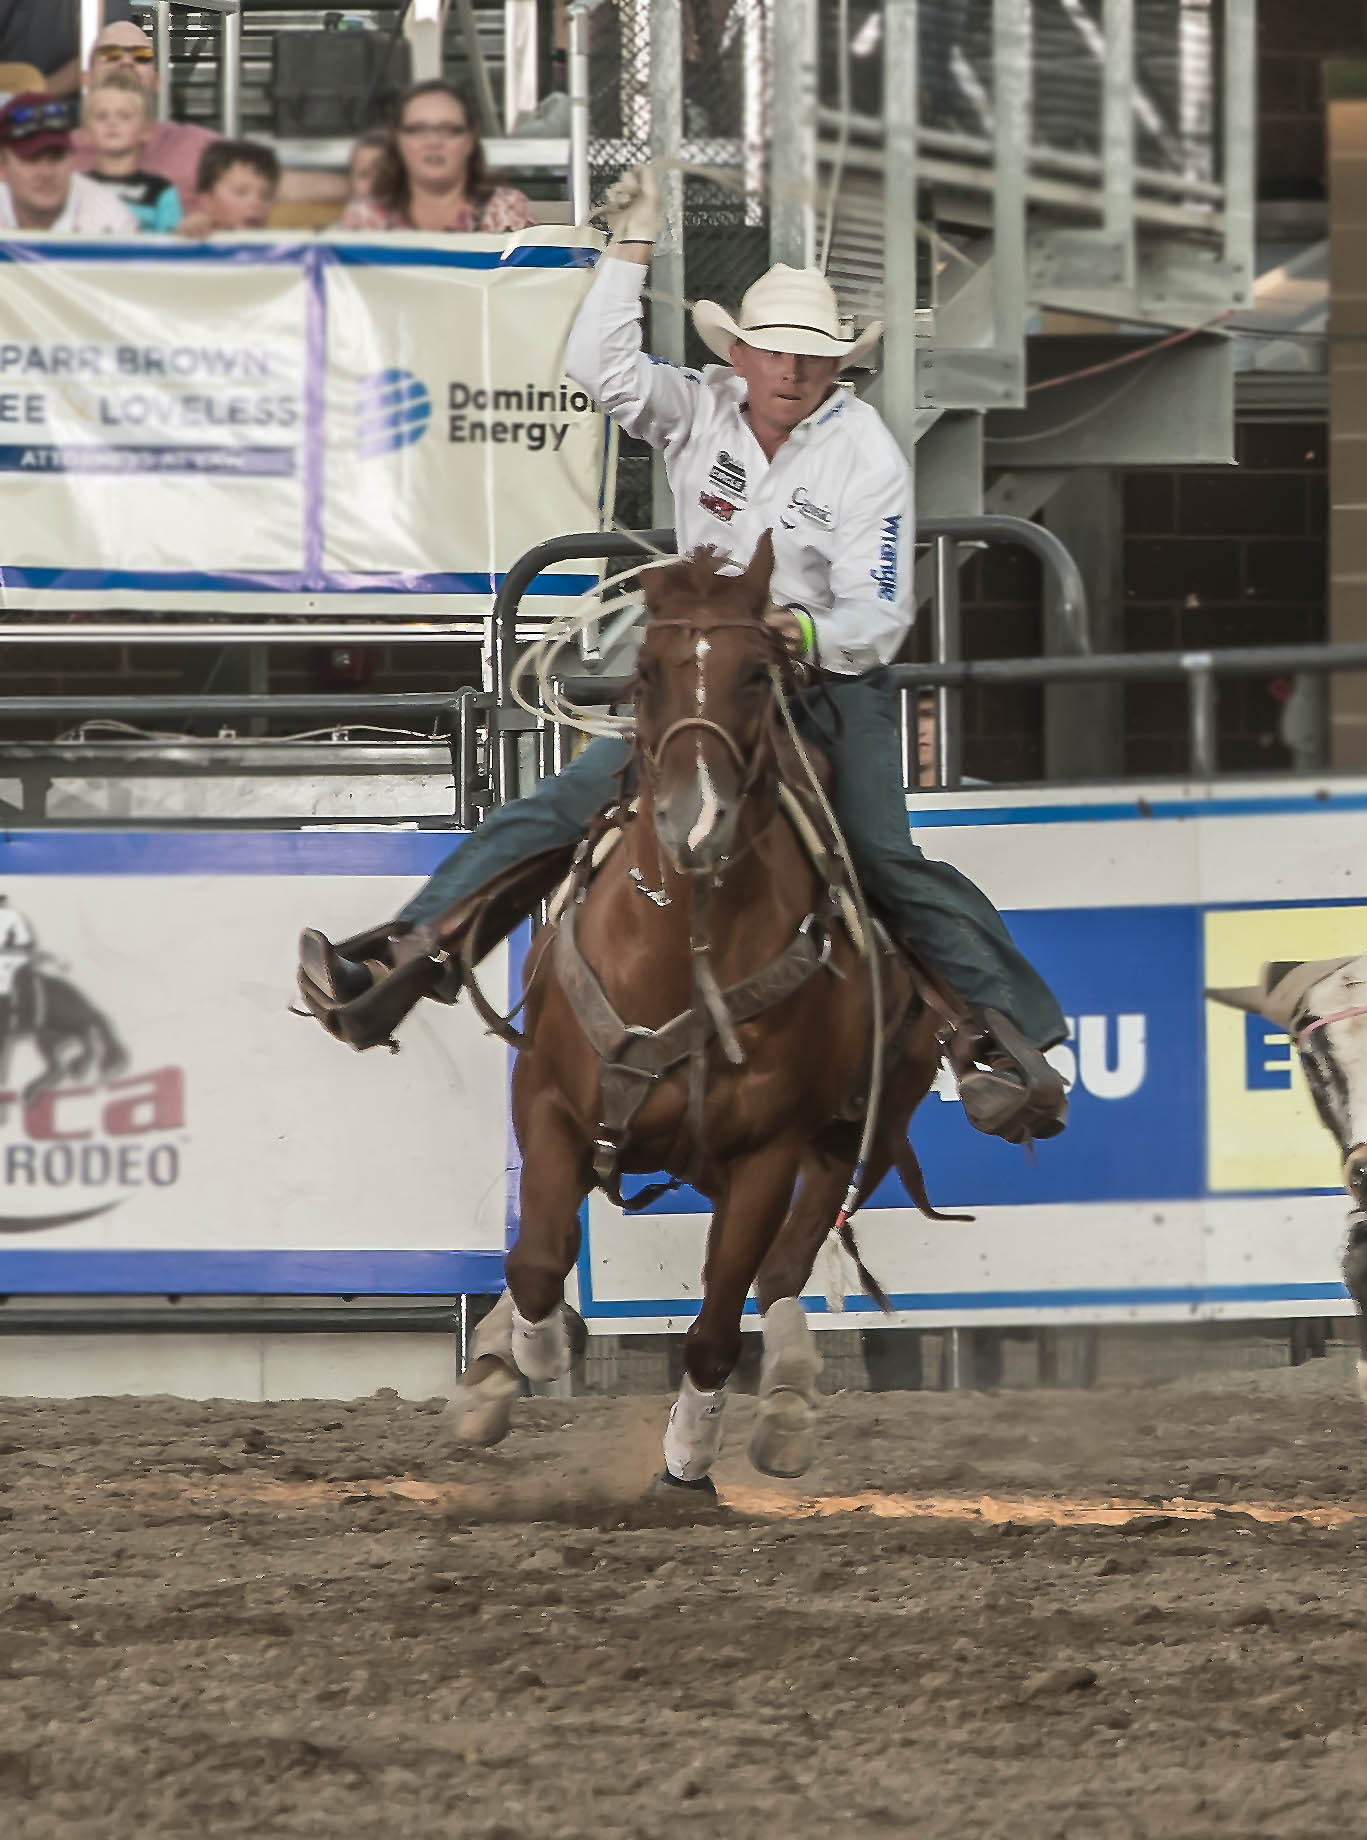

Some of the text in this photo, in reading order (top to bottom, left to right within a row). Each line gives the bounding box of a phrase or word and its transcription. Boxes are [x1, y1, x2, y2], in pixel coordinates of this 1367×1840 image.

[1, 345, 269, 376] PARR BROWN
[100, 394, 298, 426] LOVELESS
[449, 414, 569, 452] Energy
[5, 1143, 181, 1188] RODEO
